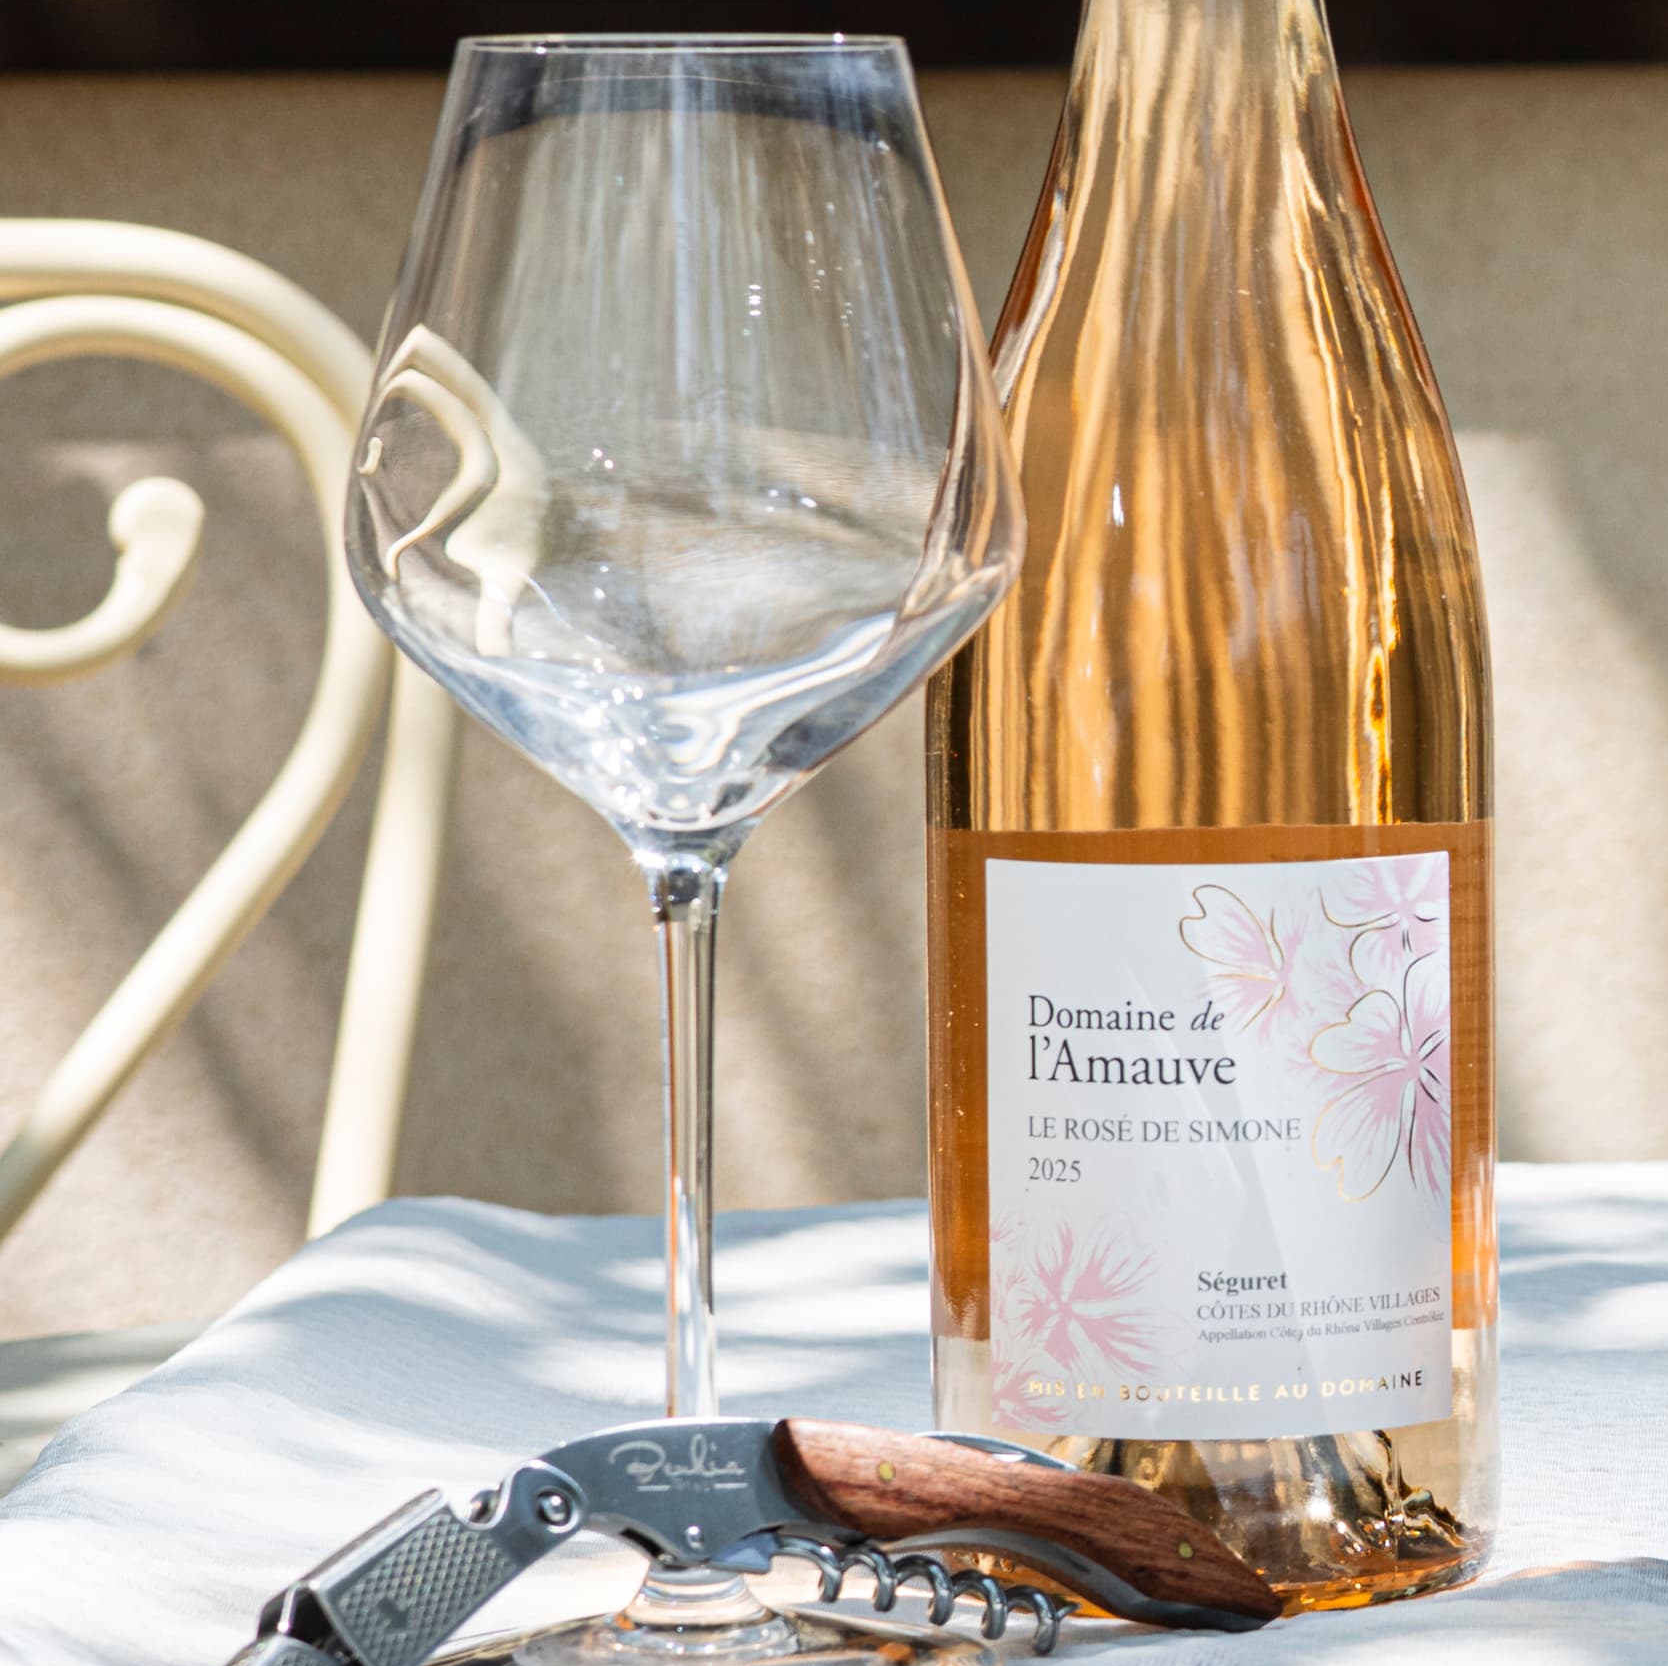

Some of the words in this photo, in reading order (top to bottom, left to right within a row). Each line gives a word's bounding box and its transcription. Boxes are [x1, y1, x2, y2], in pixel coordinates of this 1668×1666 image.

[1028, 994, 1175, 1031] Domaine
[1190, 1000, 1225, 1031] de
[1028, 1115, 1056, 1139] LE
[1064, 1112, 1134, 1142] ROSÉ
[1142, 1120, 1180, 1143] DE
[1189, 1118, 1302, 1143] SIMONE
[1028, 1156, 1082, 1183] 2025
[1197, 1271, 1288, 1296] Séguret
[1196, 1300, 1262, 1321] CÔTES
[1266, 1302, 1295, 1319] DU
[1300, 1295, 1364, 1318] RHÔNE
[1368, 1286, 1442, 1311] VILLAGES
[1197, 1328, 1267, 1344] Appellation
[1307, 1324, 1322, 1338] du
[1325, 1319, 1361, 1336] Rhône
[1364, 1316, 1402, 1332] Villages
[1028, 1380, 1066, 1398] MIS
[1075, 1382, 1105, 1400] EN
[1119, 1383, 1261, 1403] BOUTEILLE
[1274, 1382, 1308, 1400] AU
[1321, 1369, 1424, 1399] DOMAINE
